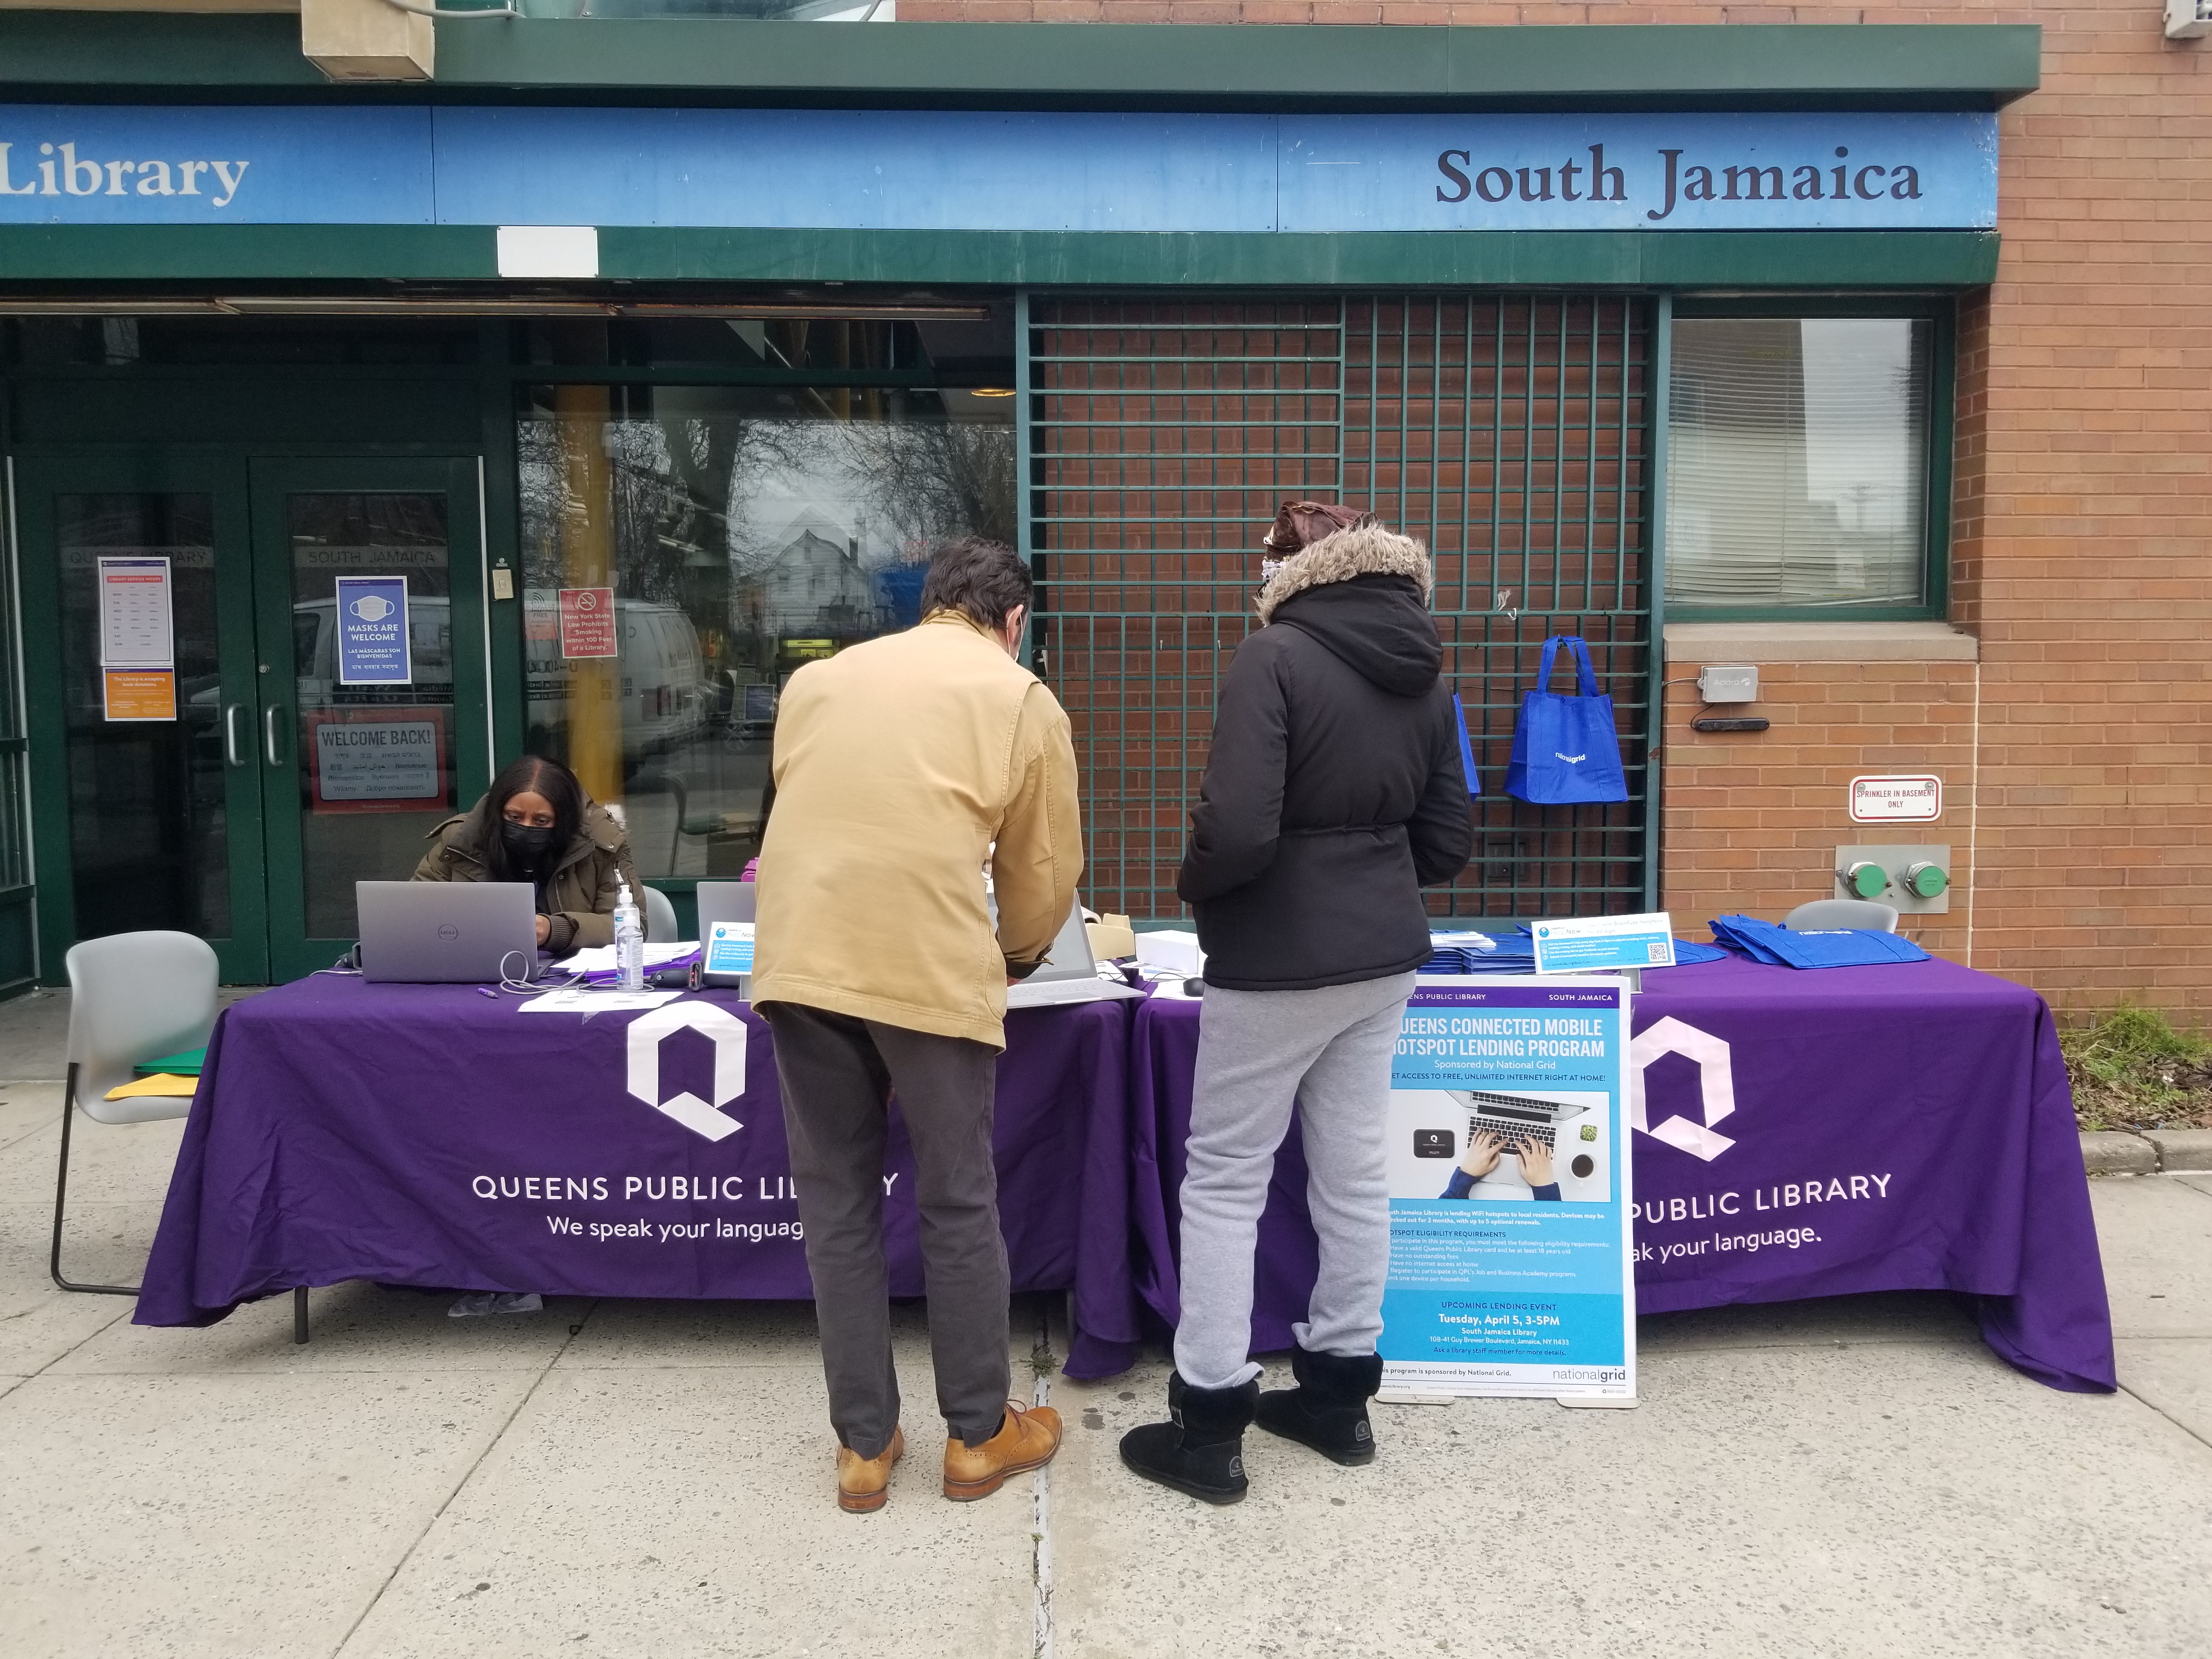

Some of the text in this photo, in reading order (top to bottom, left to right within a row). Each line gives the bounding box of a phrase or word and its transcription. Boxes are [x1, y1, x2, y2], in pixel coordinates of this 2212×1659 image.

[0, 140, 250, 207] Library
[1436, 144, 1923, 220] South Jamaica
[309, 551, 436, 563] SOUTH JAMAICA
[321, 730, 431, 747] WELCOME BACK!
[1555, 752, 1585, 764] naonalgrid
[1400, 1018, 1602, 1036] UEENS CONNECTED MOBILE
[1393, 1039, 1604, 1057] OTSPOT LENDING PROGRAM
[1435, 1060, 1556, 1070] Sponsored by National Grid
[472, 1175, 610, 1200] QUEENS
[625, 1176, 743, 1200] PUBLIC
[1756, 1173, 1891, 1211] LIBRARY
[546, 1215, 804, 1243] We speak your languag
[1660, 1239, 1710, 1264] your
[1716, 1227, 1822, 1252] language.
[1438, 1313, 1560, 1327] Tuesday, April 5, 3-5PM
[1513, 1329, 1537, 1337] Library
[1553, 1368, 1626, 1383] nationalgrid
